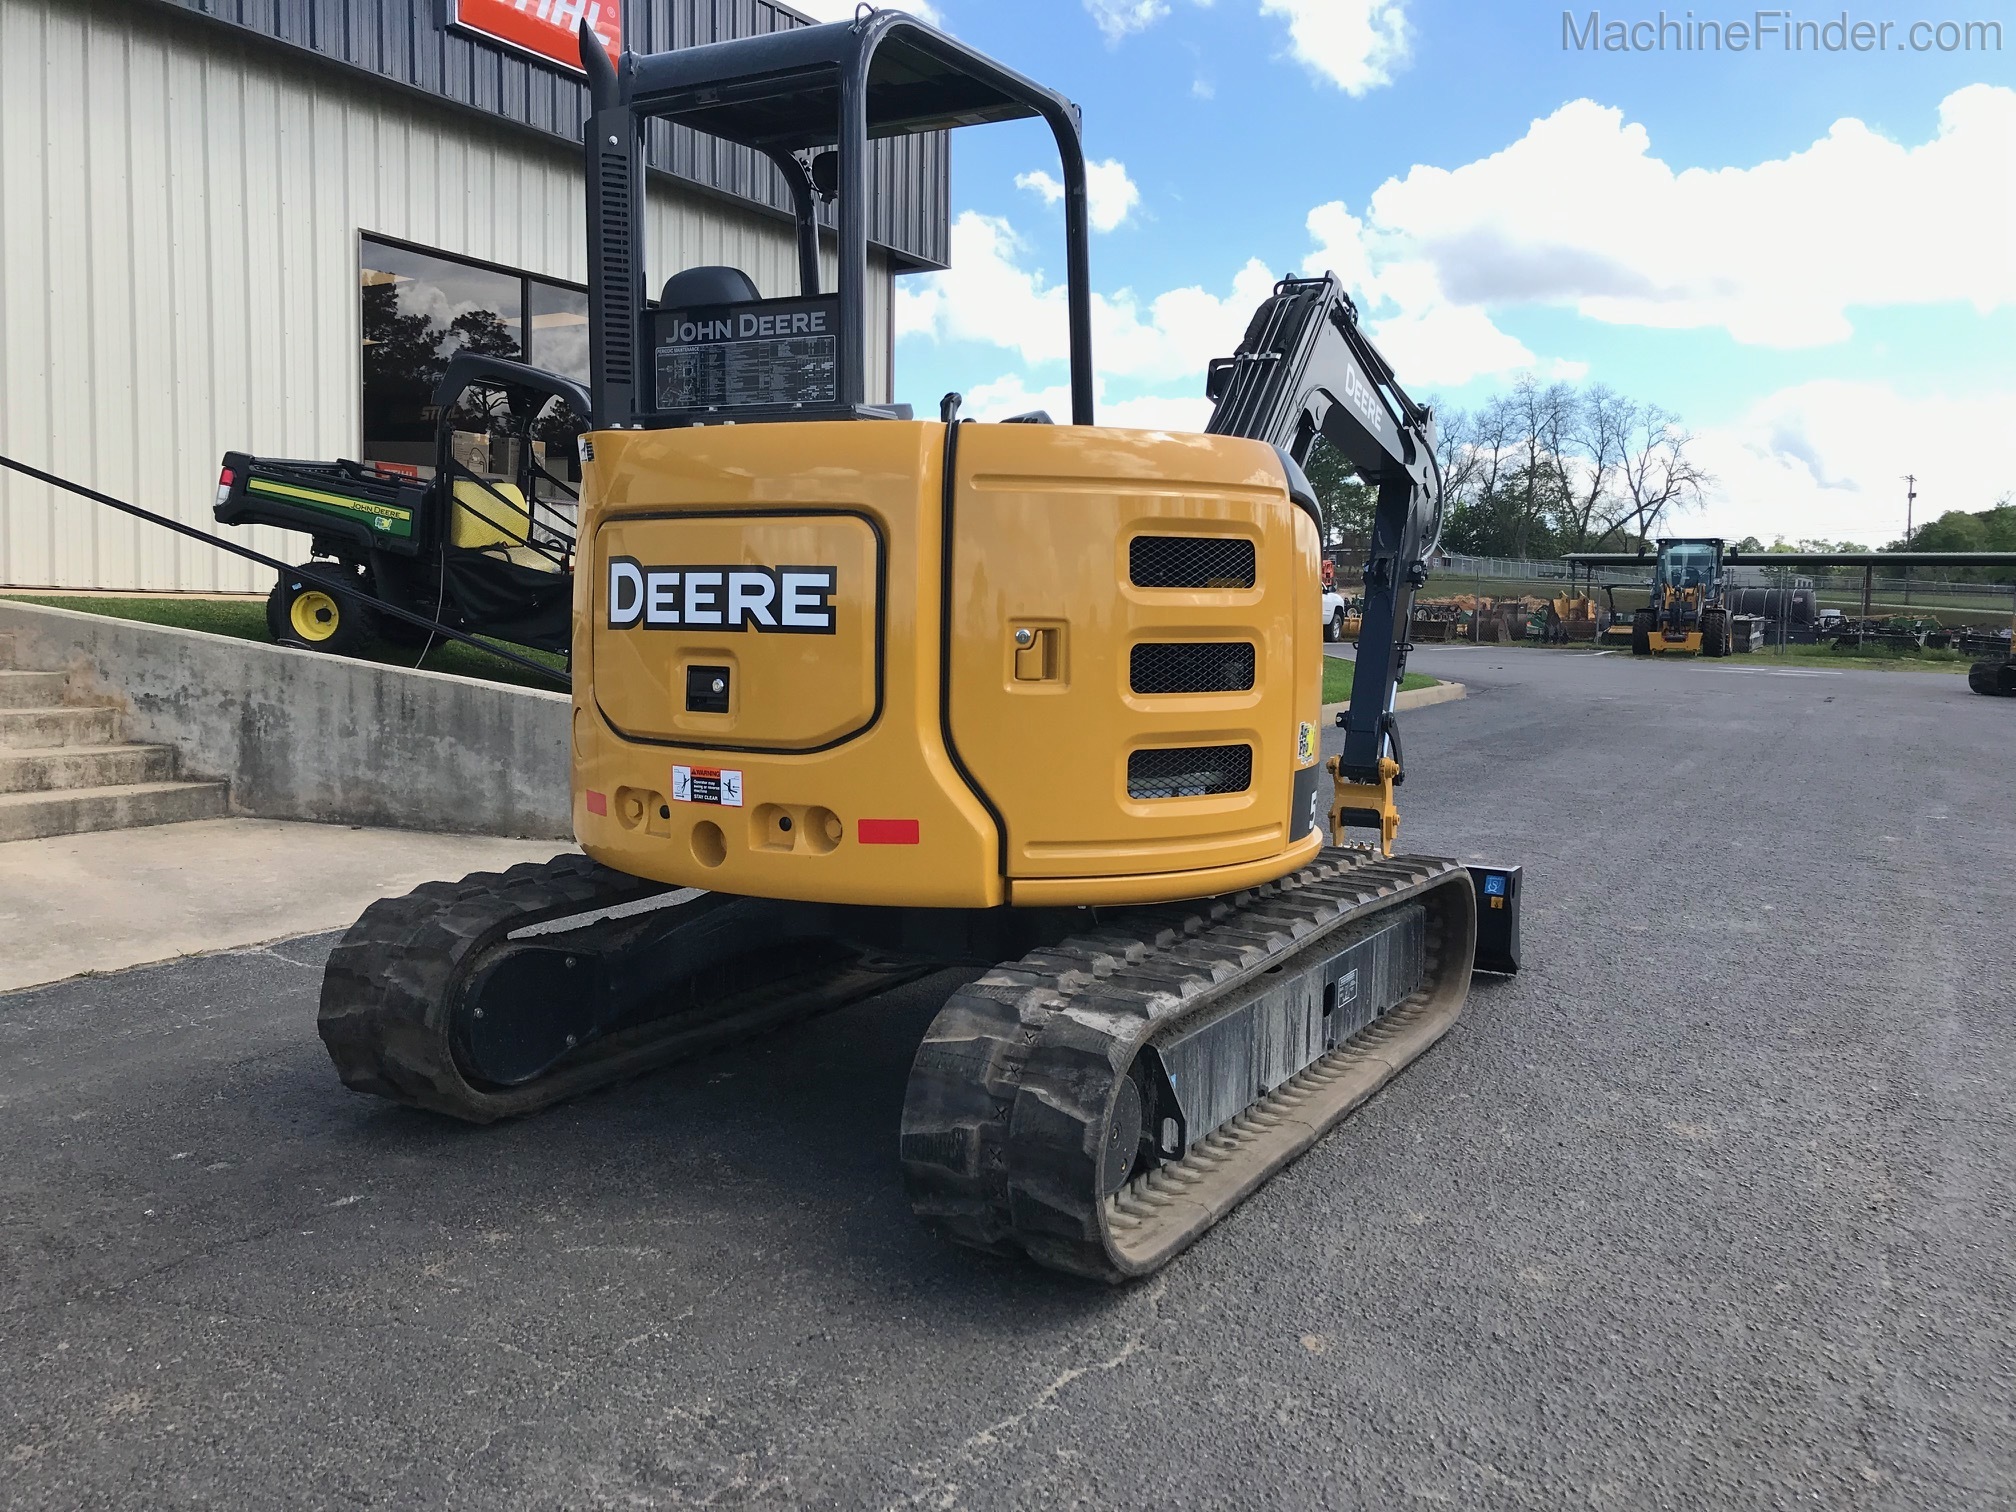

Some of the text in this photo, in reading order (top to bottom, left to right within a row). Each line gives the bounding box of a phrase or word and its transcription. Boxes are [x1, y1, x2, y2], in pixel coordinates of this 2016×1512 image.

[665, 311, 826, 343] JOHN DEERE
[1345, 362, 1383, 432] DEERE
[350, 502, 401, 518] JOHN DEERE
[610, 562, 830, 627] DEERE
[695, 769, 720, 777] WARNING
